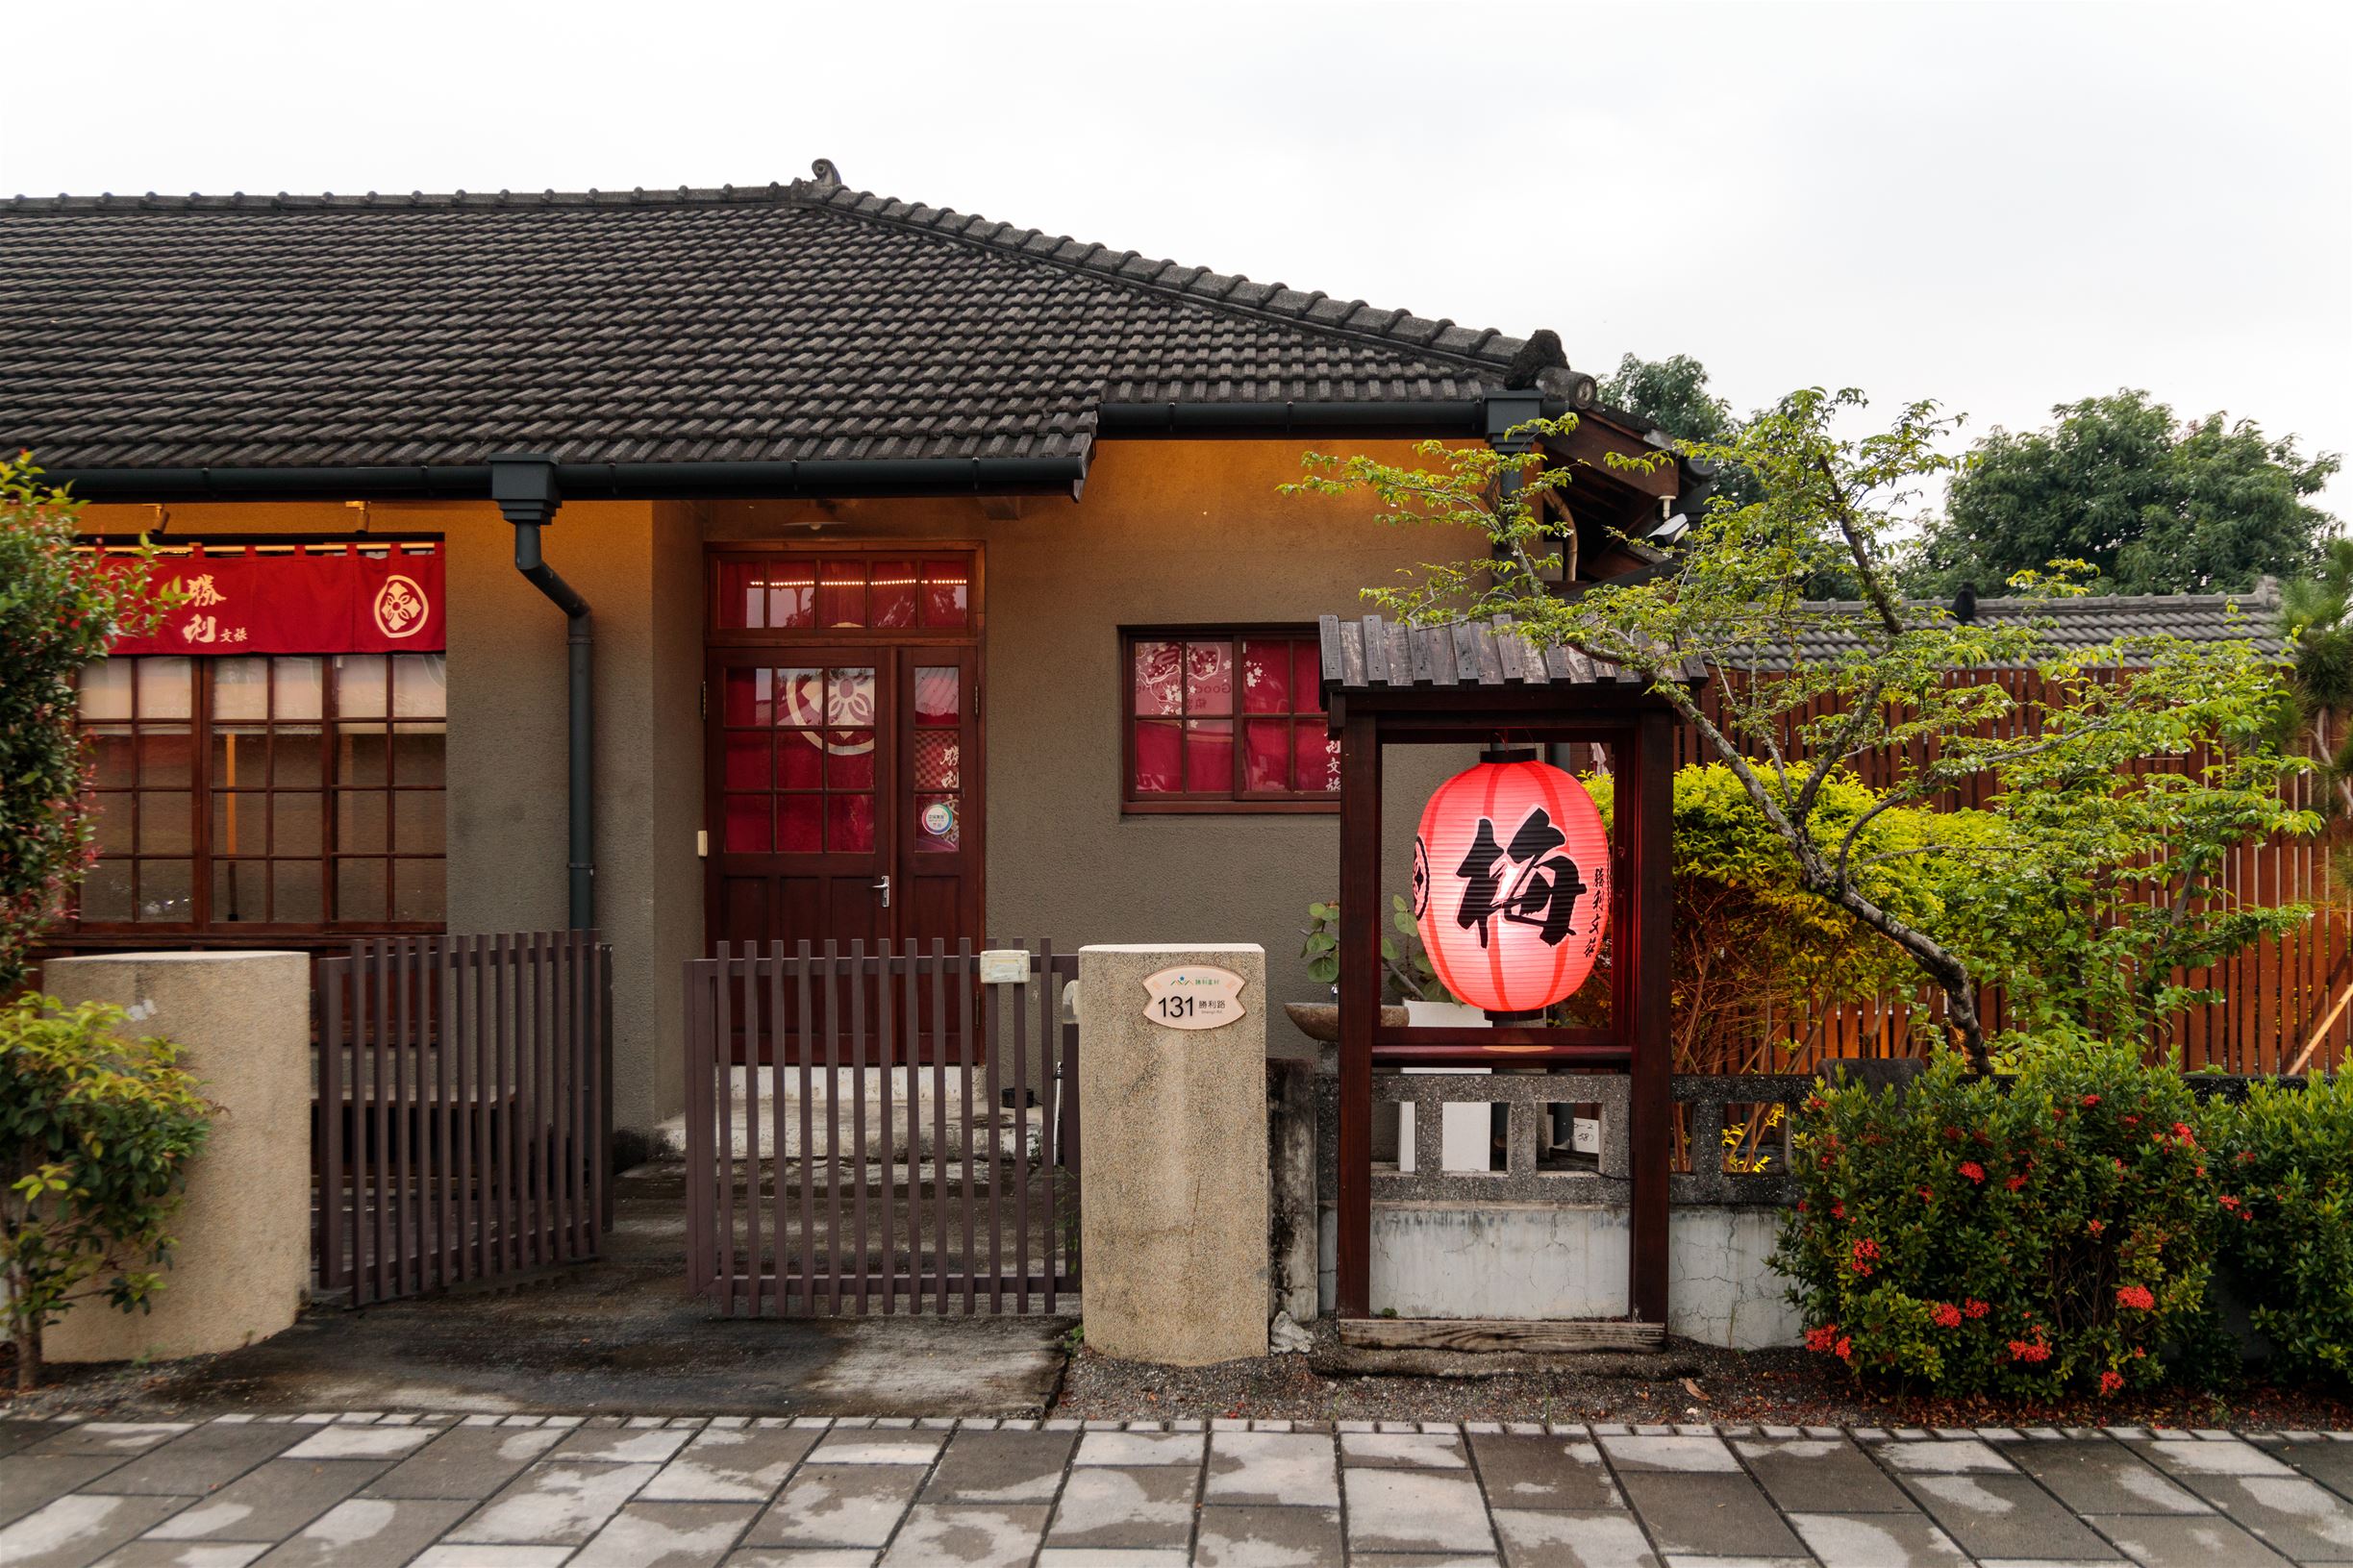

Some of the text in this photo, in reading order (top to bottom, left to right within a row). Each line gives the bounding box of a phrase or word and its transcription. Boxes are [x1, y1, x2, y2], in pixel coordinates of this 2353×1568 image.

[181, 574, 227, 643] 勝利
[1456, 807, 1588, 949] 梅
[1158, 995, 1193, 1018] 131
[1198, 1000, 1226, 1008] 勝利路
